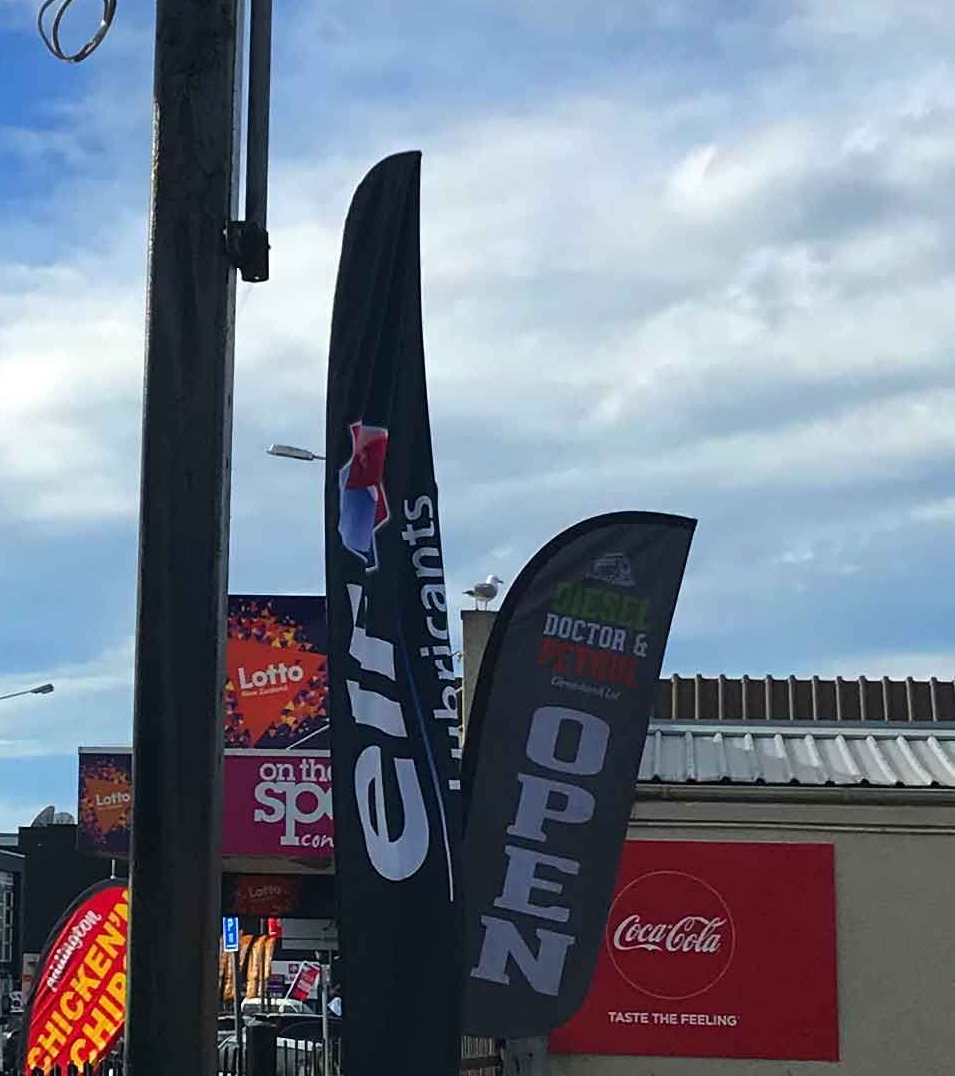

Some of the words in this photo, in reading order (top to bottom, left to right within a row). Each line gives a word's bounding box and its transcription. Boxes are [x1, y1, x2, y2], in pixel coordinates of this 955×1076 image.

[543, 612, 626, 652] DOCTOR
[633, 633, 649, 658] &
[238, 663, 304, 689] Lotto
[259, 762, 296, 781] on
[96, 792, 131, 807] Lotto
[470, 705, 610, 997] OPEN
[70, 954, 127, 1074] CHIP
[608, 1011, 649, 1024] TASTE
[651, 1013, 678, 1025] THE
[681, 1014, 738, 1026] FEELING
